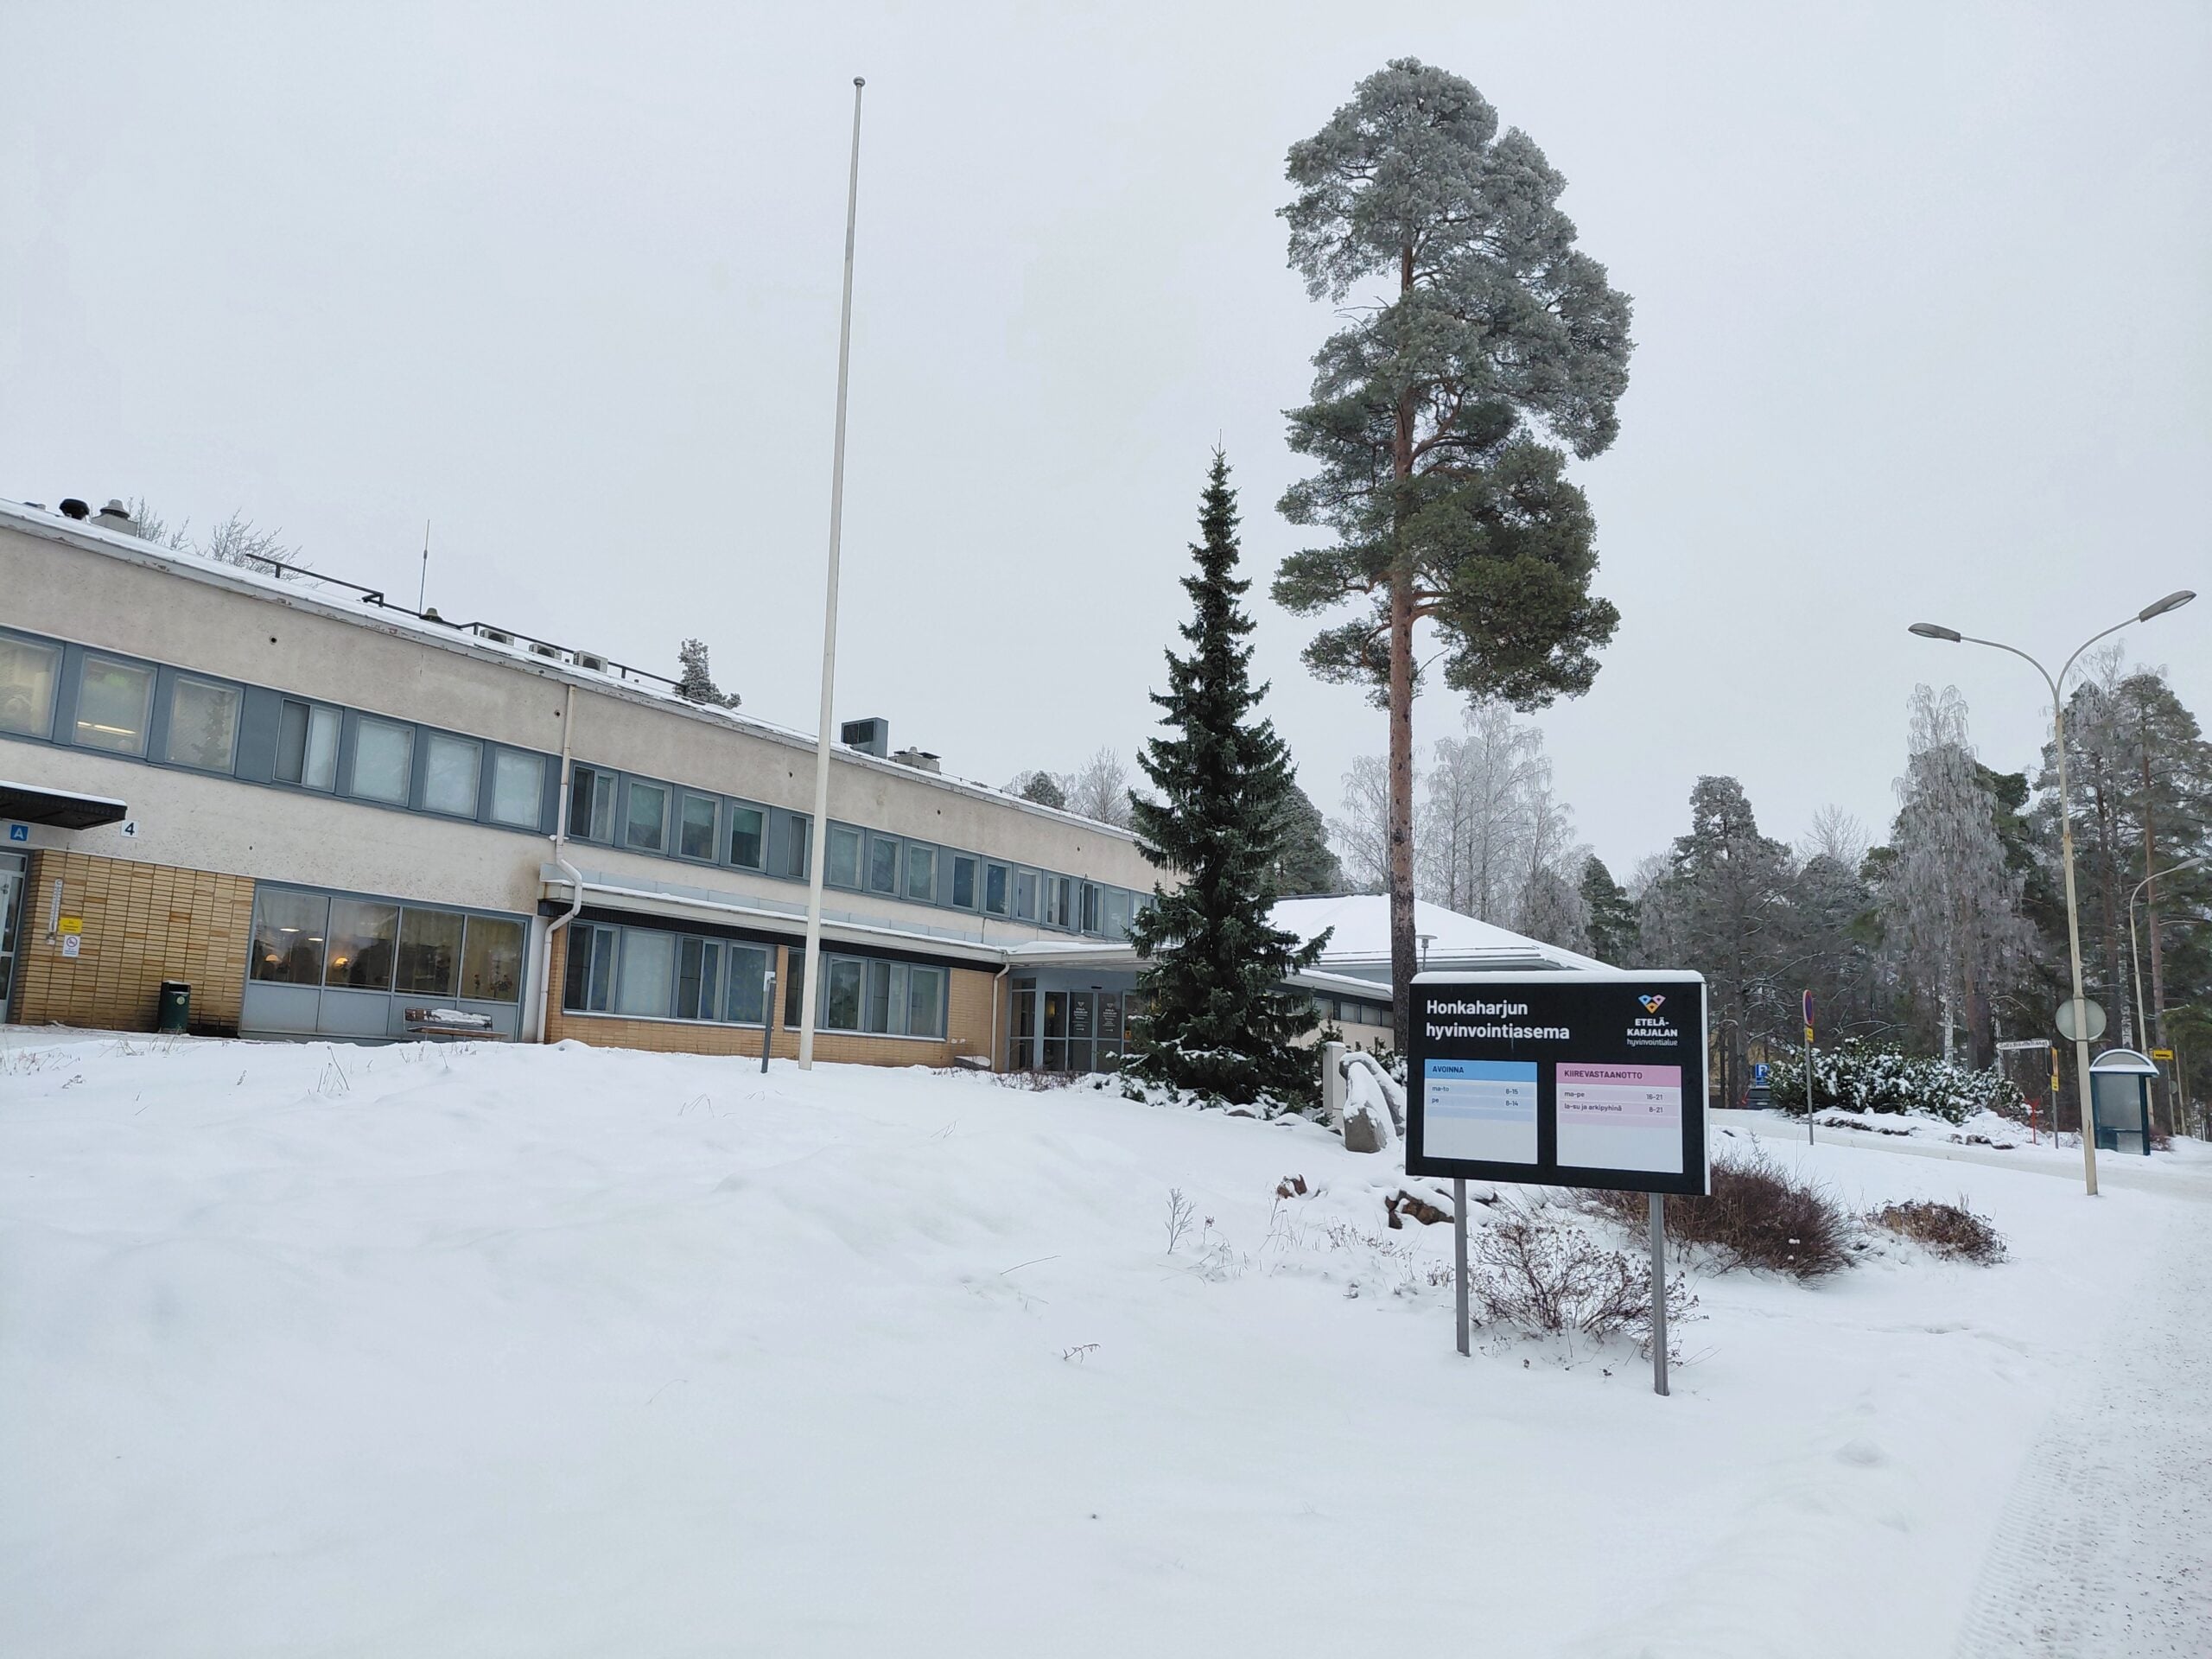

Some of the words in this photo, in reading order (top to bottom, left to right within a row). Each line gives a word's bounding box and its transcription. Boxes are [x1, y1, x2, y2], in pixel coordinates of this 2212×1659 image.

[13, 828, 24, 839] A
[124, 823, 135, 836] 4
[1427, 1000, 1529, 1019] Honkaharjun
[1635, 1016, 1669, 1027] ETELÄ-
[1426, 1022, 1570, 1040] hyvinvointiasema
[1627, 1028, 1678, 1037] KARJALAN
[1564, 1070, 1643, 1079] KIIREVASTAANOTTO
[1758, 1065, 1768, 1076] P
